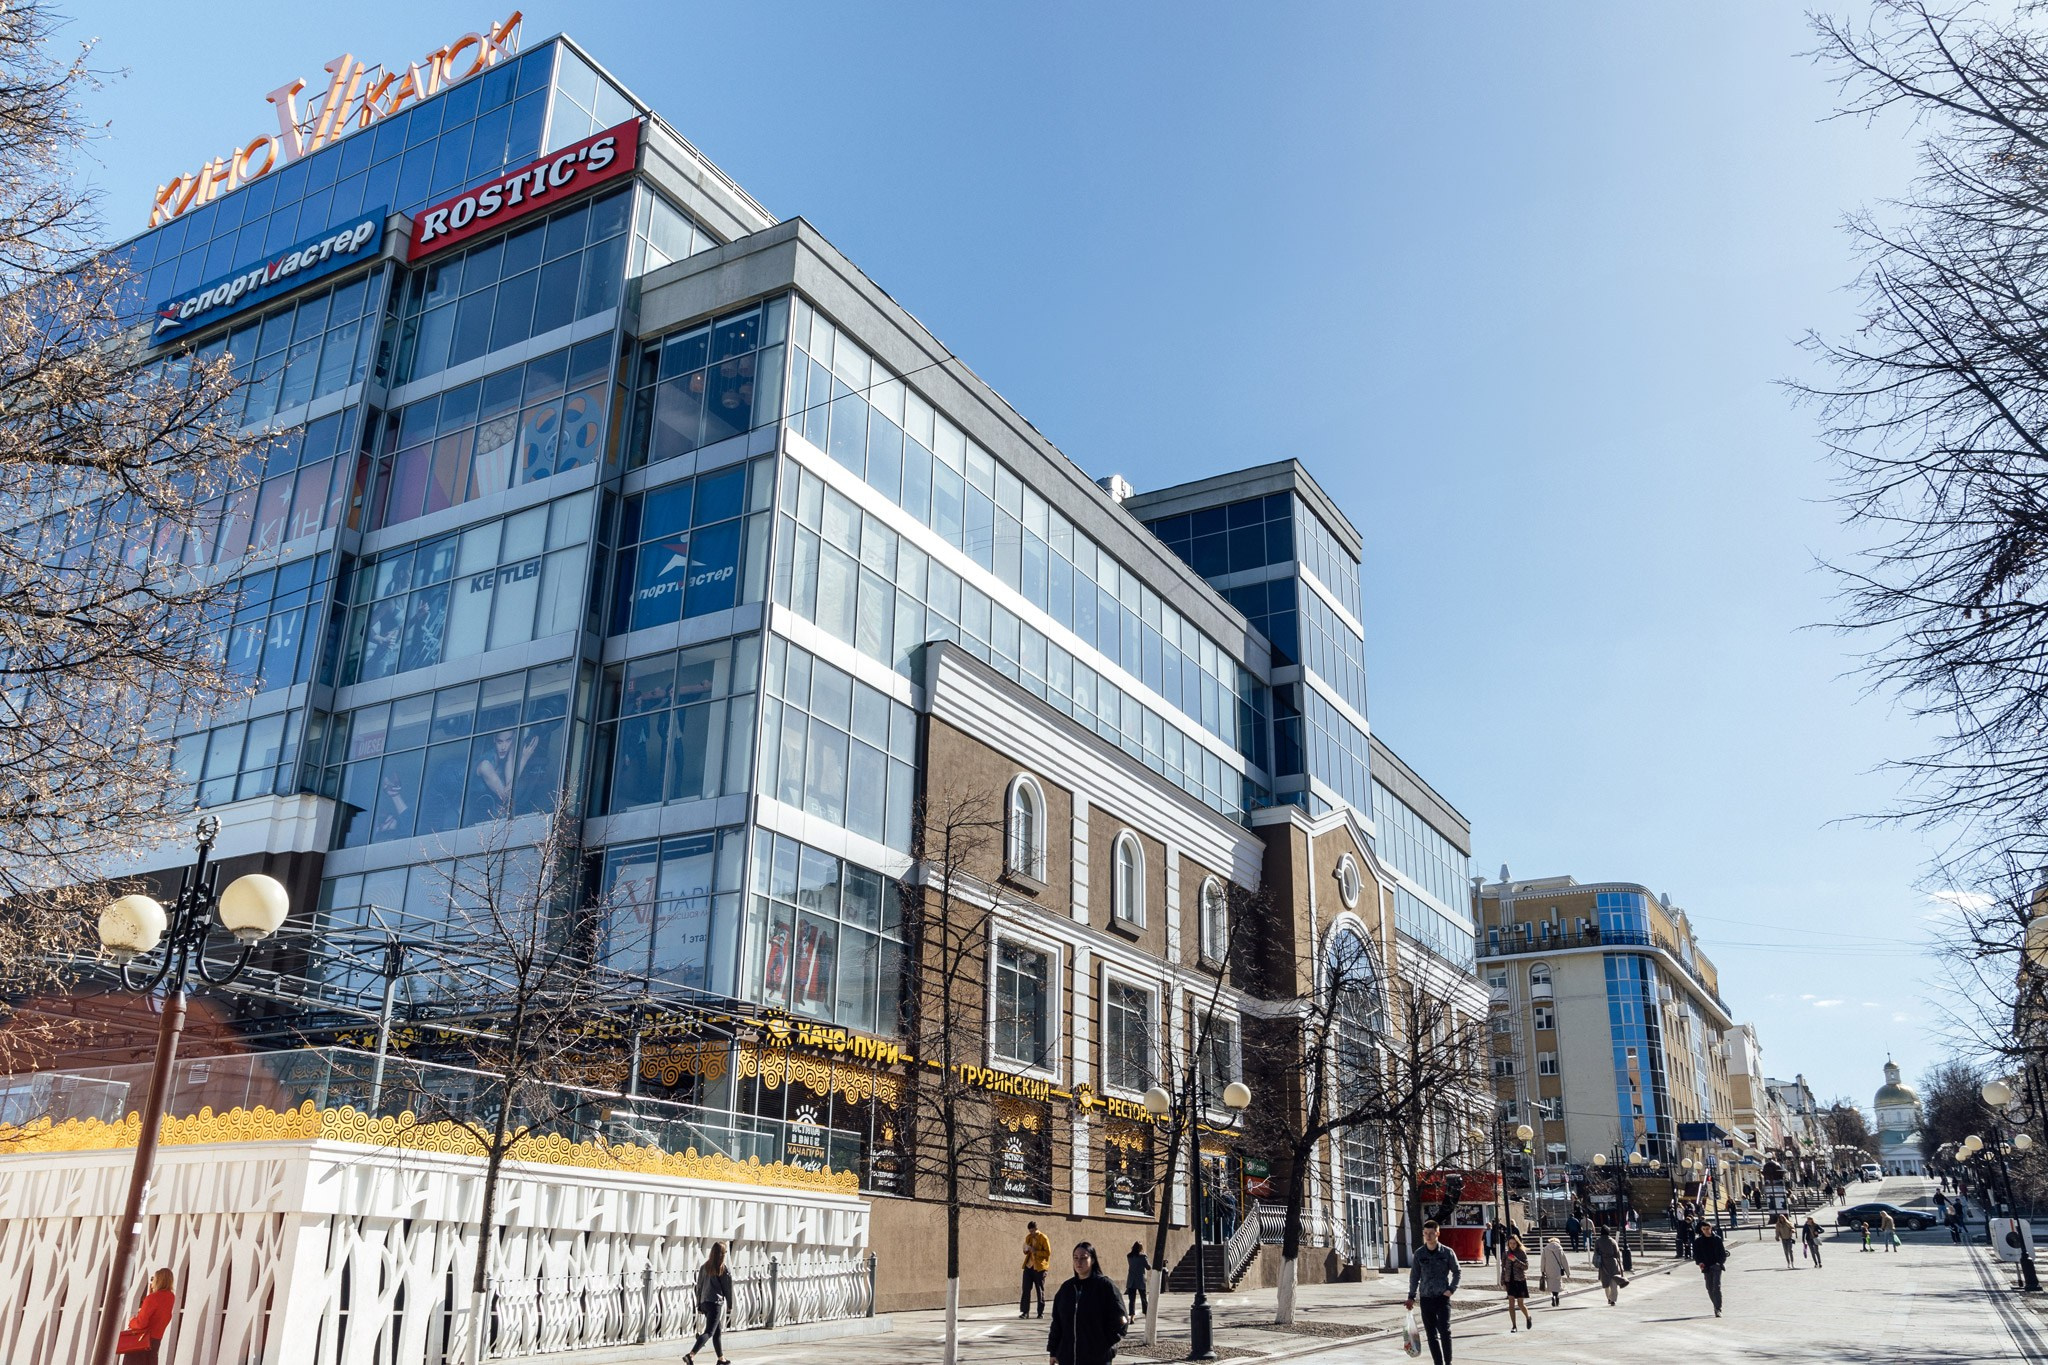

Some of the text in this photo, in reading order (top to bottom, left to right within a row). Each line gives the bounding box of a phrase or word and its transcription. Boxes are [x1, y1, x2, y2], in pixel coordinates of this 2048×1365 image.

[147, 133, 279, 228] КИНО
[358, 10, 523, 128] КАТОК
[419, 136, 616, 244] ROSTIC'S
[689, 934, 708, 944] эта
[797, 1022, 847, 1053] ХАЧО
[854, 1035, 899, 1065] ПУРИ
[959, 1063, 1050, 1101] ГРУЗИНСКИЙ
[1108, 1097, 1161, 1125] РЕСТОРА
[786, 1145, 826, 1159] ХАЧАПУРИ
